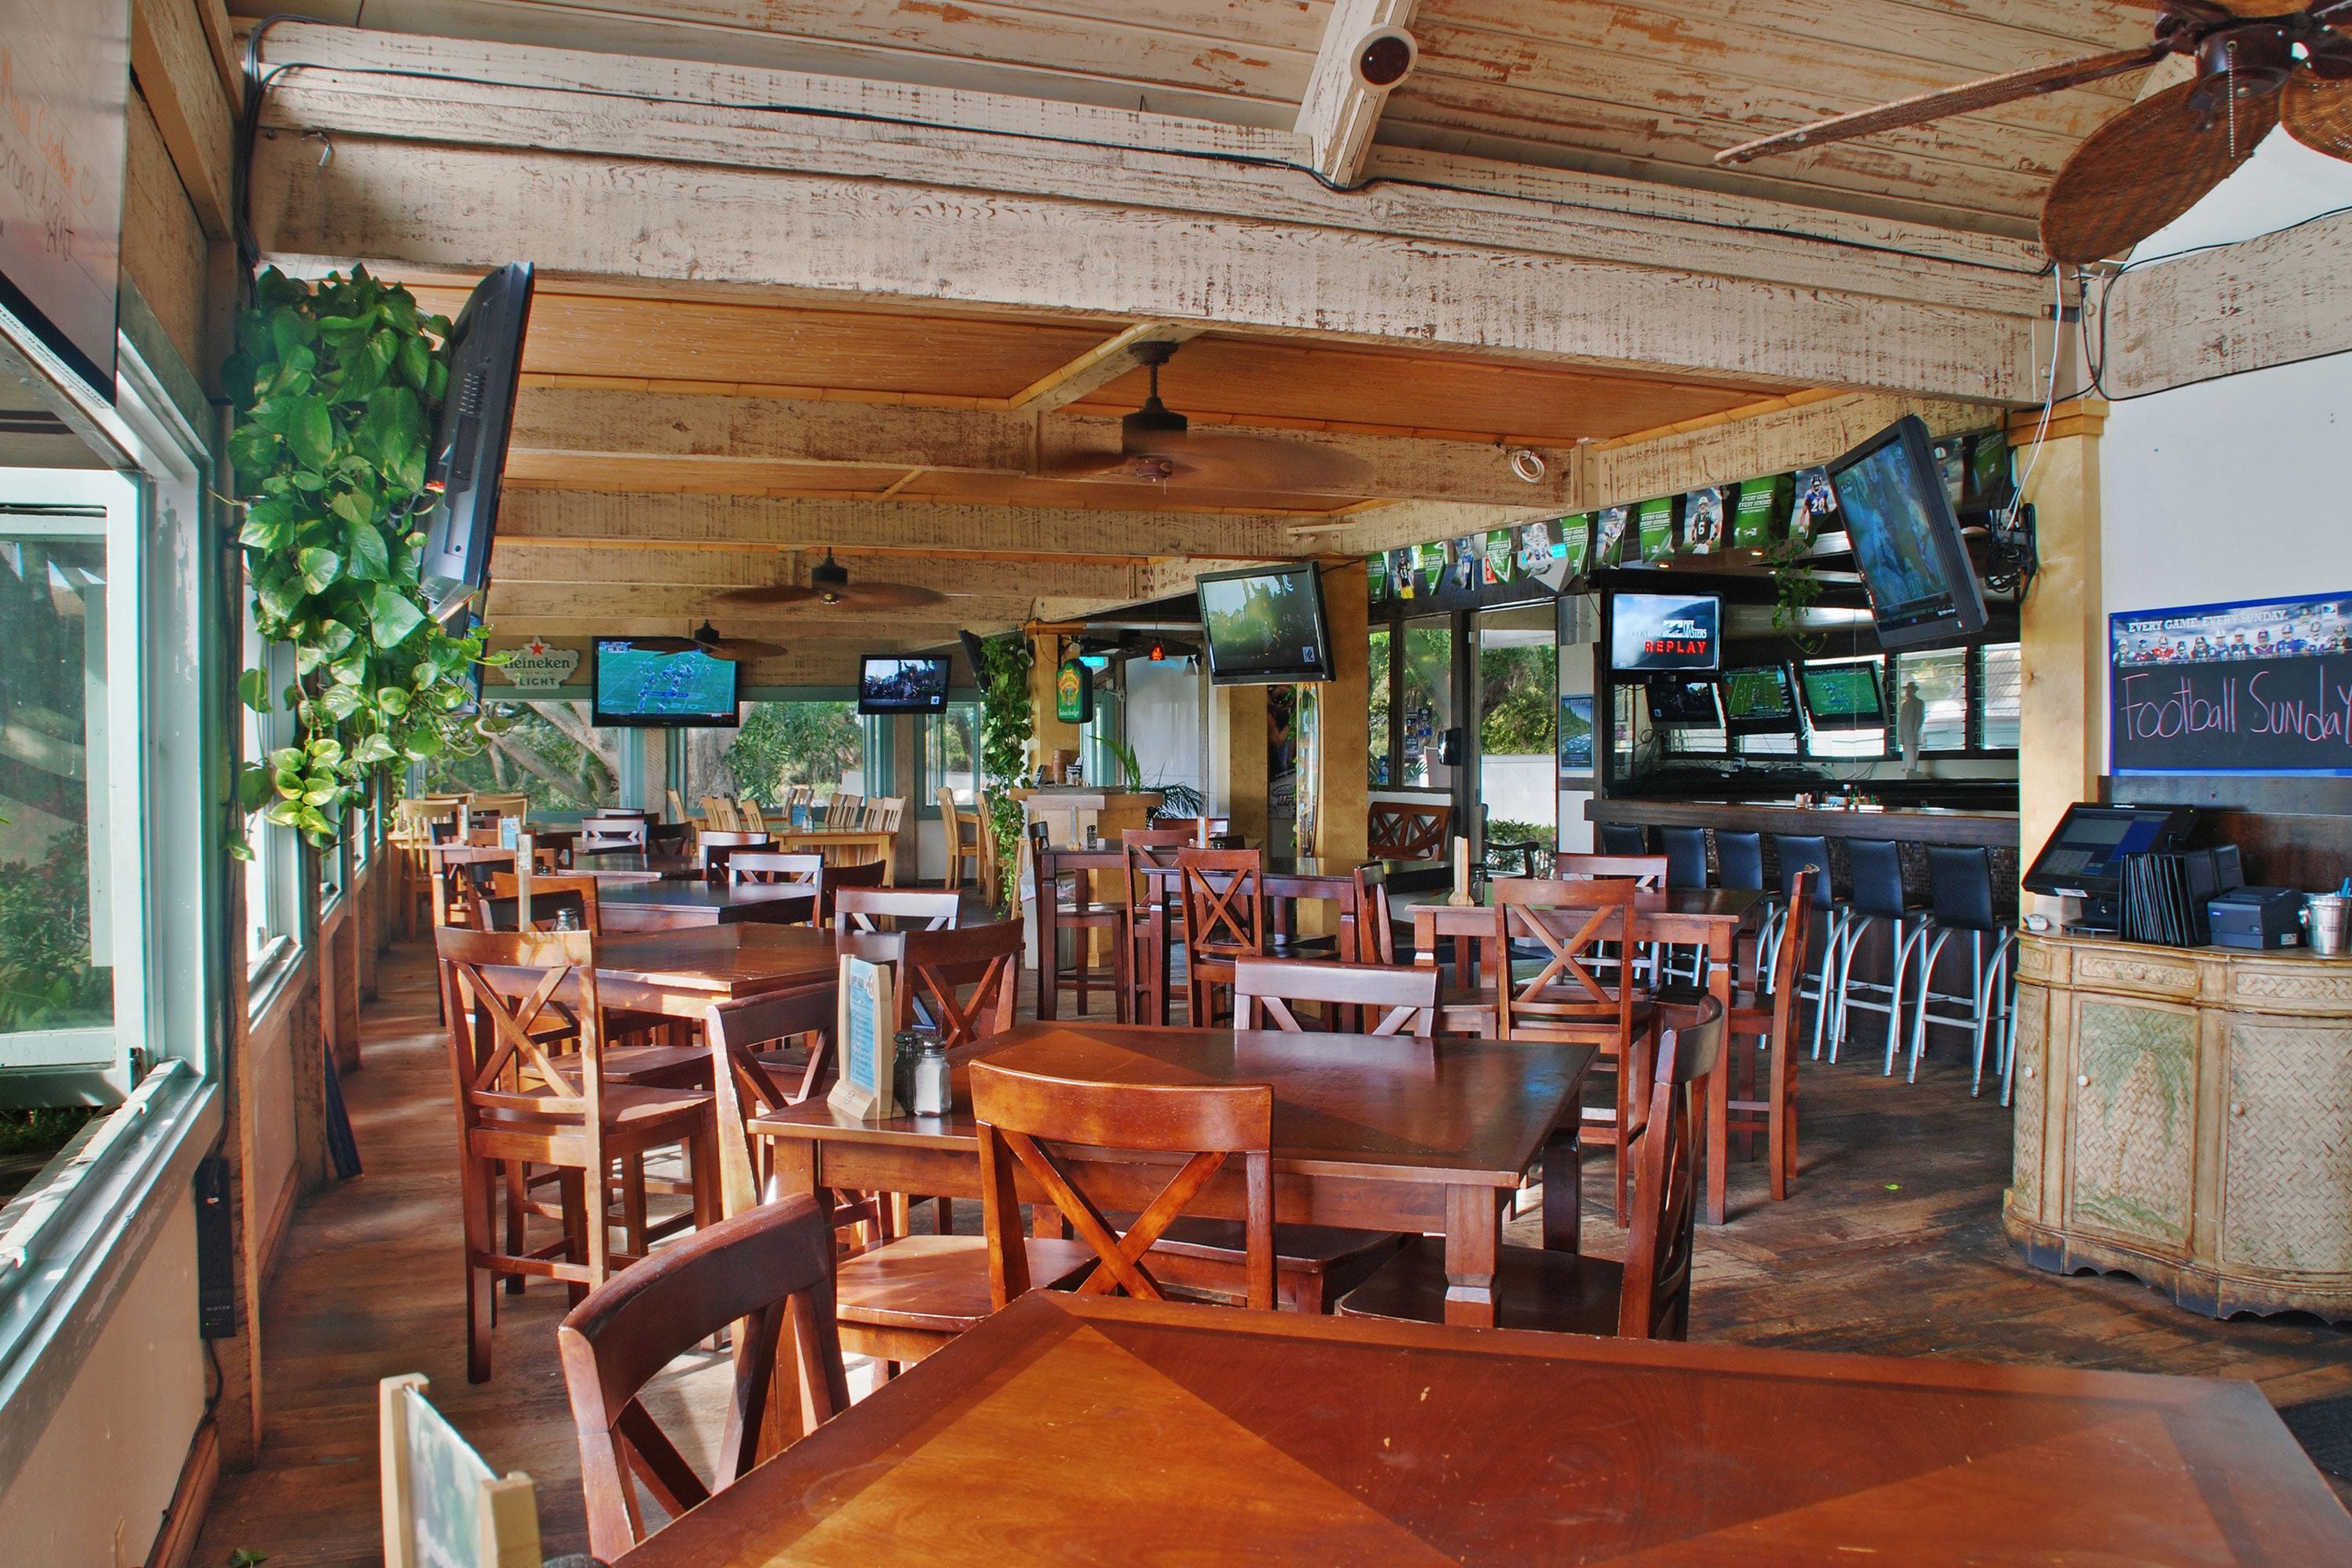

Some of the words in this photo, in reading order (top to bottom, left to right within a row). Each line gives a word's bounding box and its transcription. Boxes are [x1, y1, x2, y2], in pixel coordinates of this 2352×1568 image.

[1698, 521, 1705, 535] 6
[2128, 620, 2163, 633] EVERY
[2201, 614, 2239, 626] EVERY
[2240, 610, 2288, 623] SUNDAY.
[1644, 641, 1707, 655] REPLAY
[2120, 673, 2237, 740] Football
